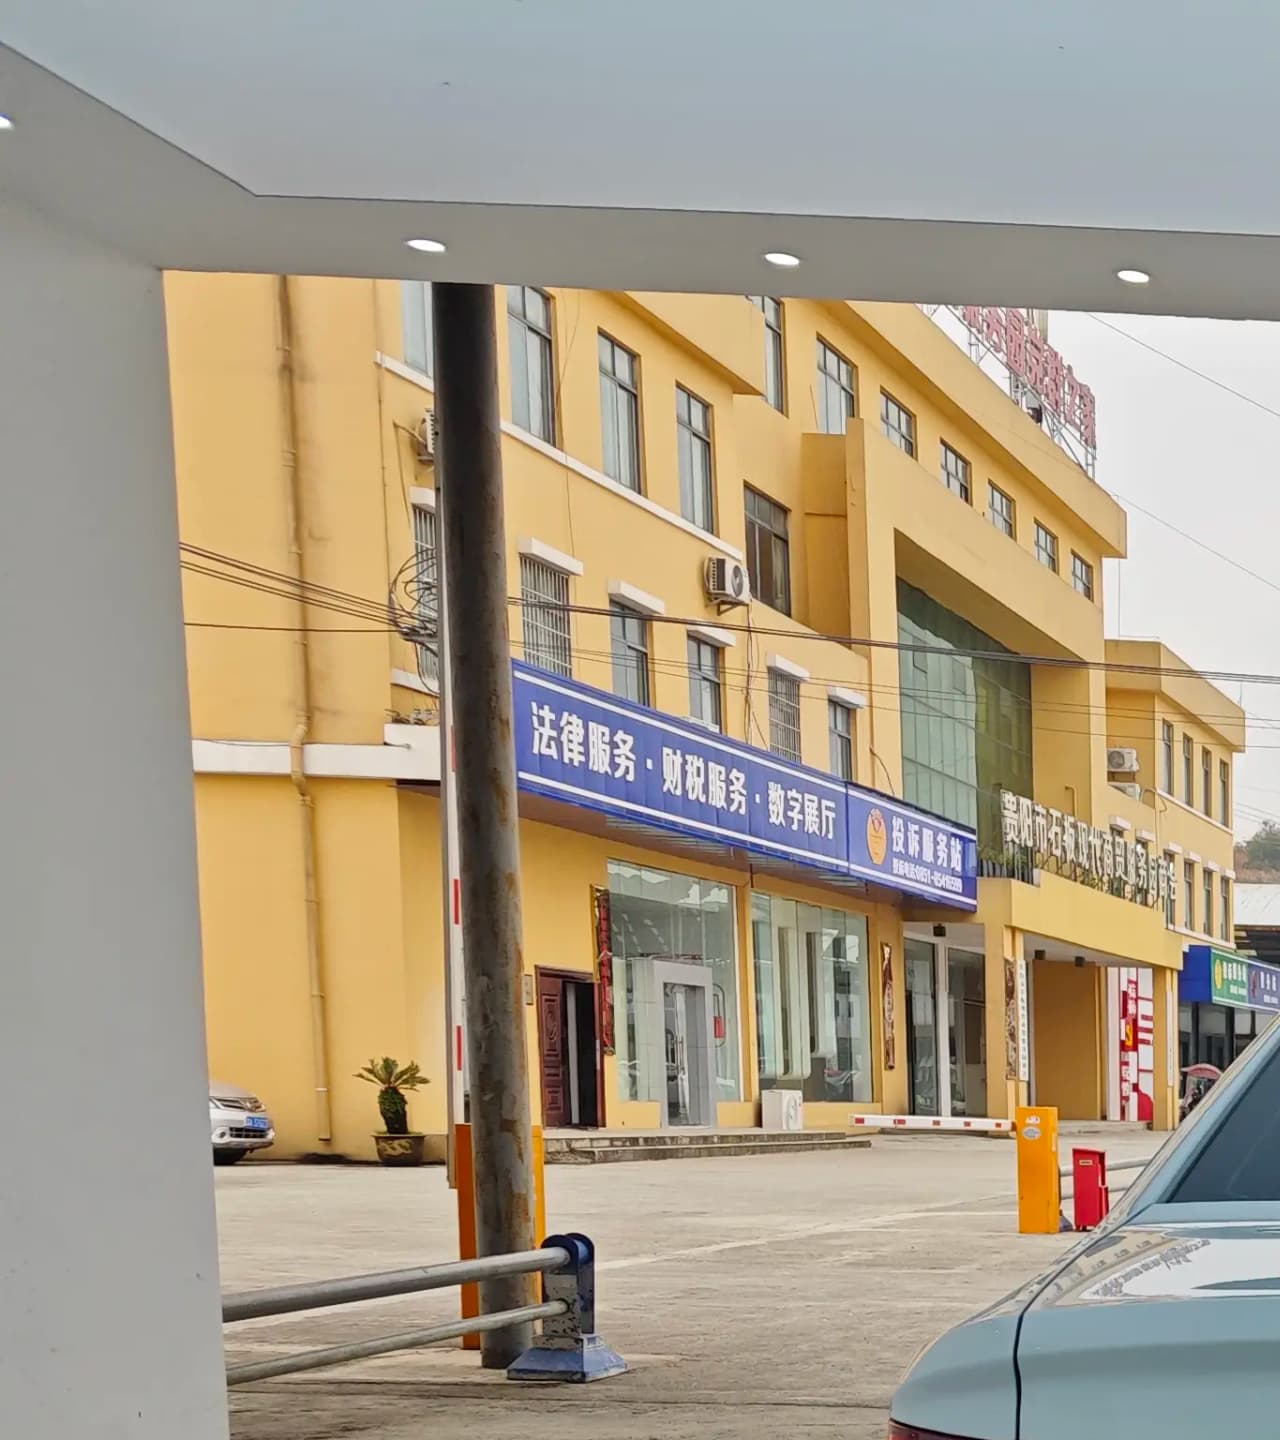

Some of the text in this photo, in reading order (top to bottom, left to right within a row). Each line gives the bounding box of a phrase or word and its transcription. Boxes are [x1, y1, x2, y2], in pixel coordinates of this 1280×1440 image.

[892, 815, 962, 873] 投诉服务站
